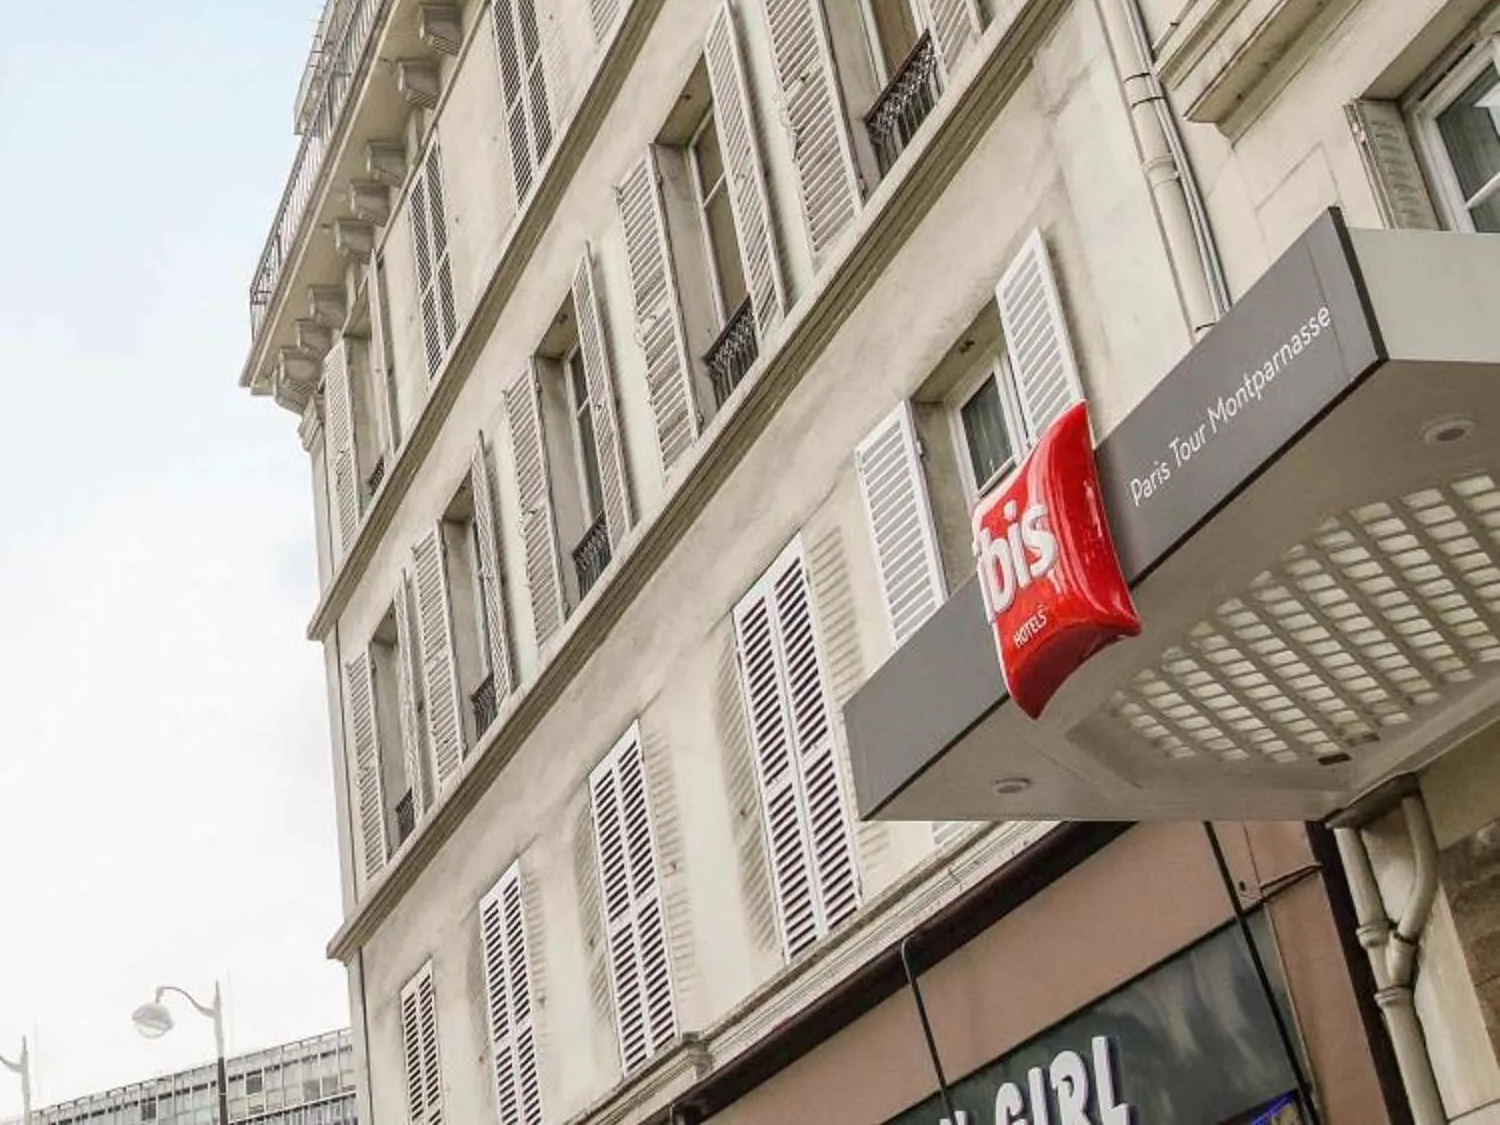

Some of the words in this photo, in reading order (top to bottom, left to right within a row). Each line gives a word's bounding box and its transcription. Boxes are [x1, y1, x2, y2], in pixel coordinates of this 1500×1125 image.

[1129, 460, 1172, 507] Paris
[1168, 424, 1211, 468] Tour
[1206, 306, 1332, 433] Montparnasse
[1012, 606, 1049, 648] HOTELS
[995, 1036, 1132, 1125] GIRL
